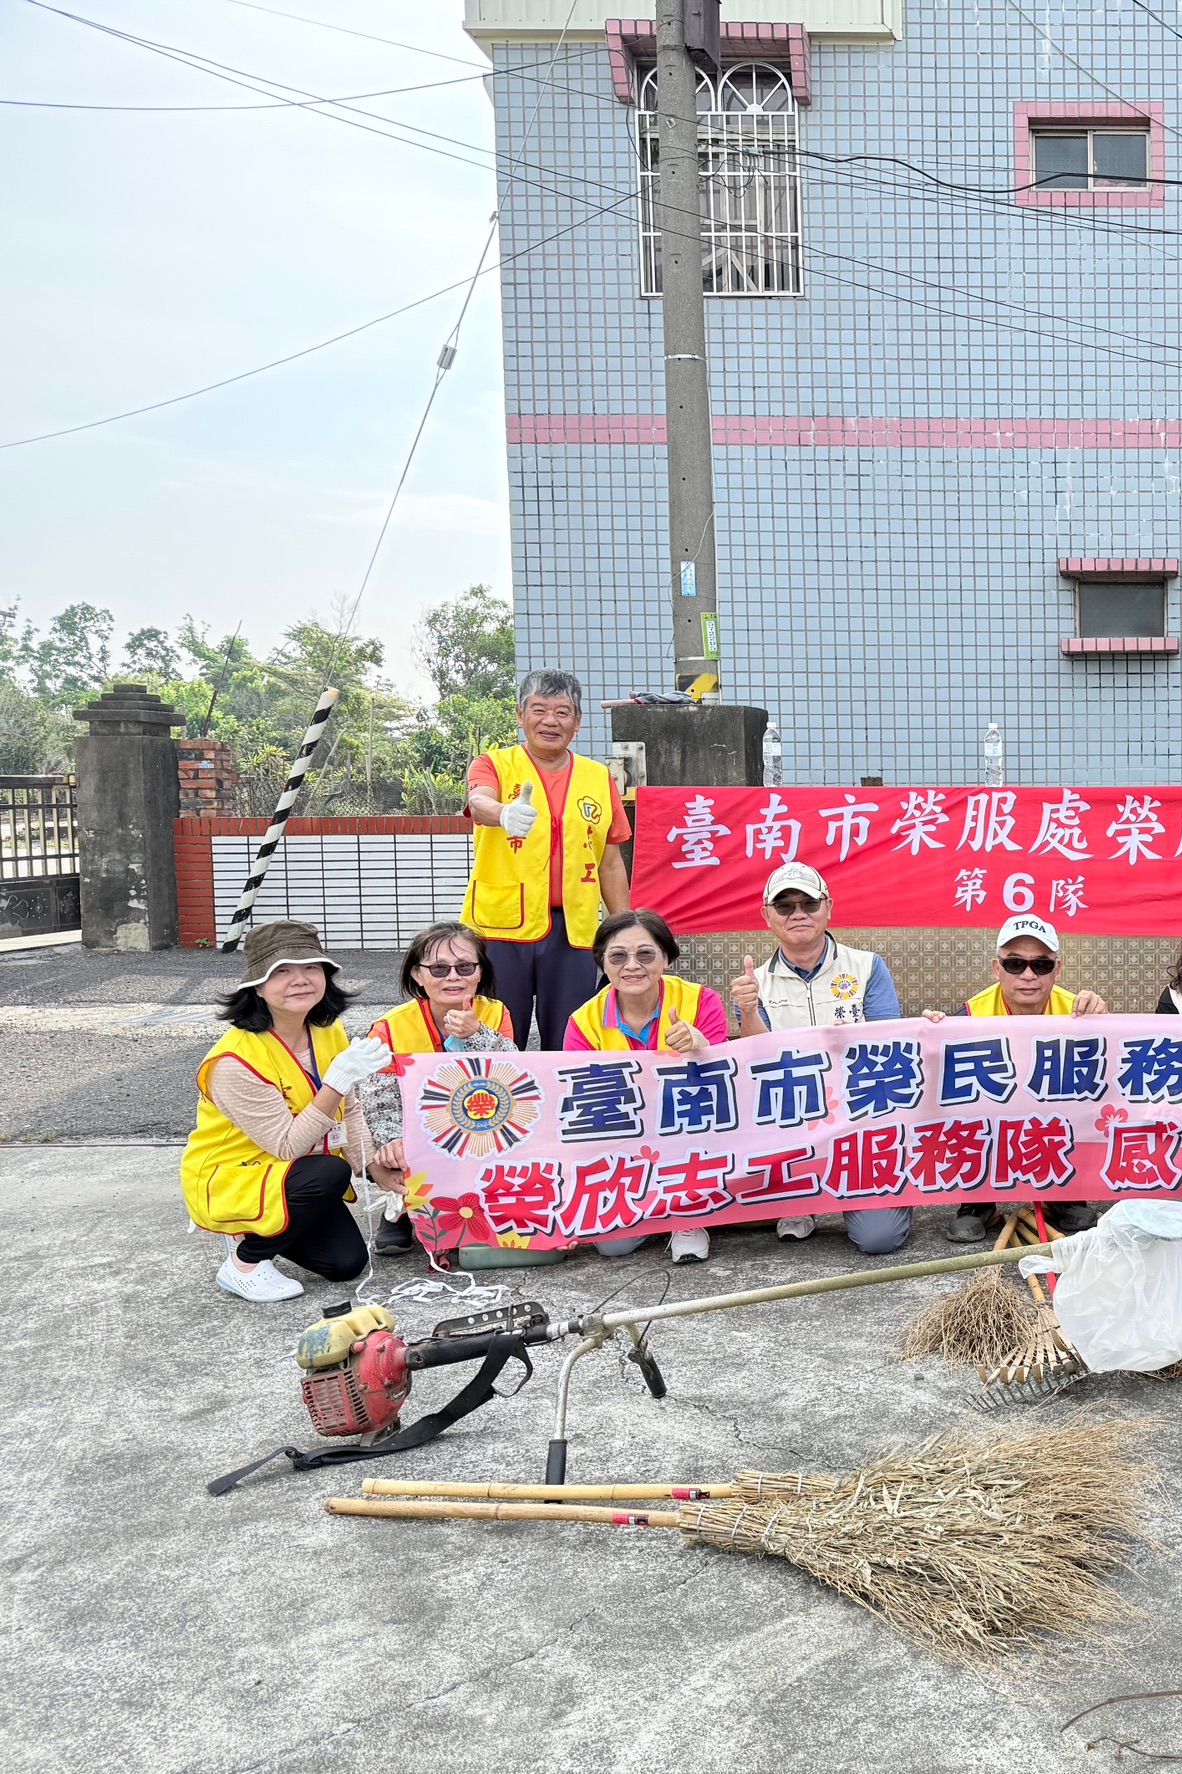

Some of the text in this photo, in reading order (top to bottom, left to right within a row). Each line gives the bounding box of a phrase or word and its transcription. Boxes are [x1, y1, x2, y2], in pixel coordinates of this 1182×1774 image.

[952, 867, 1088, 916] 第6隊
[1013, 920, 1047, 934] TPGA
[480, 1116, 1076, 1238] 榮欣志工服務隊
